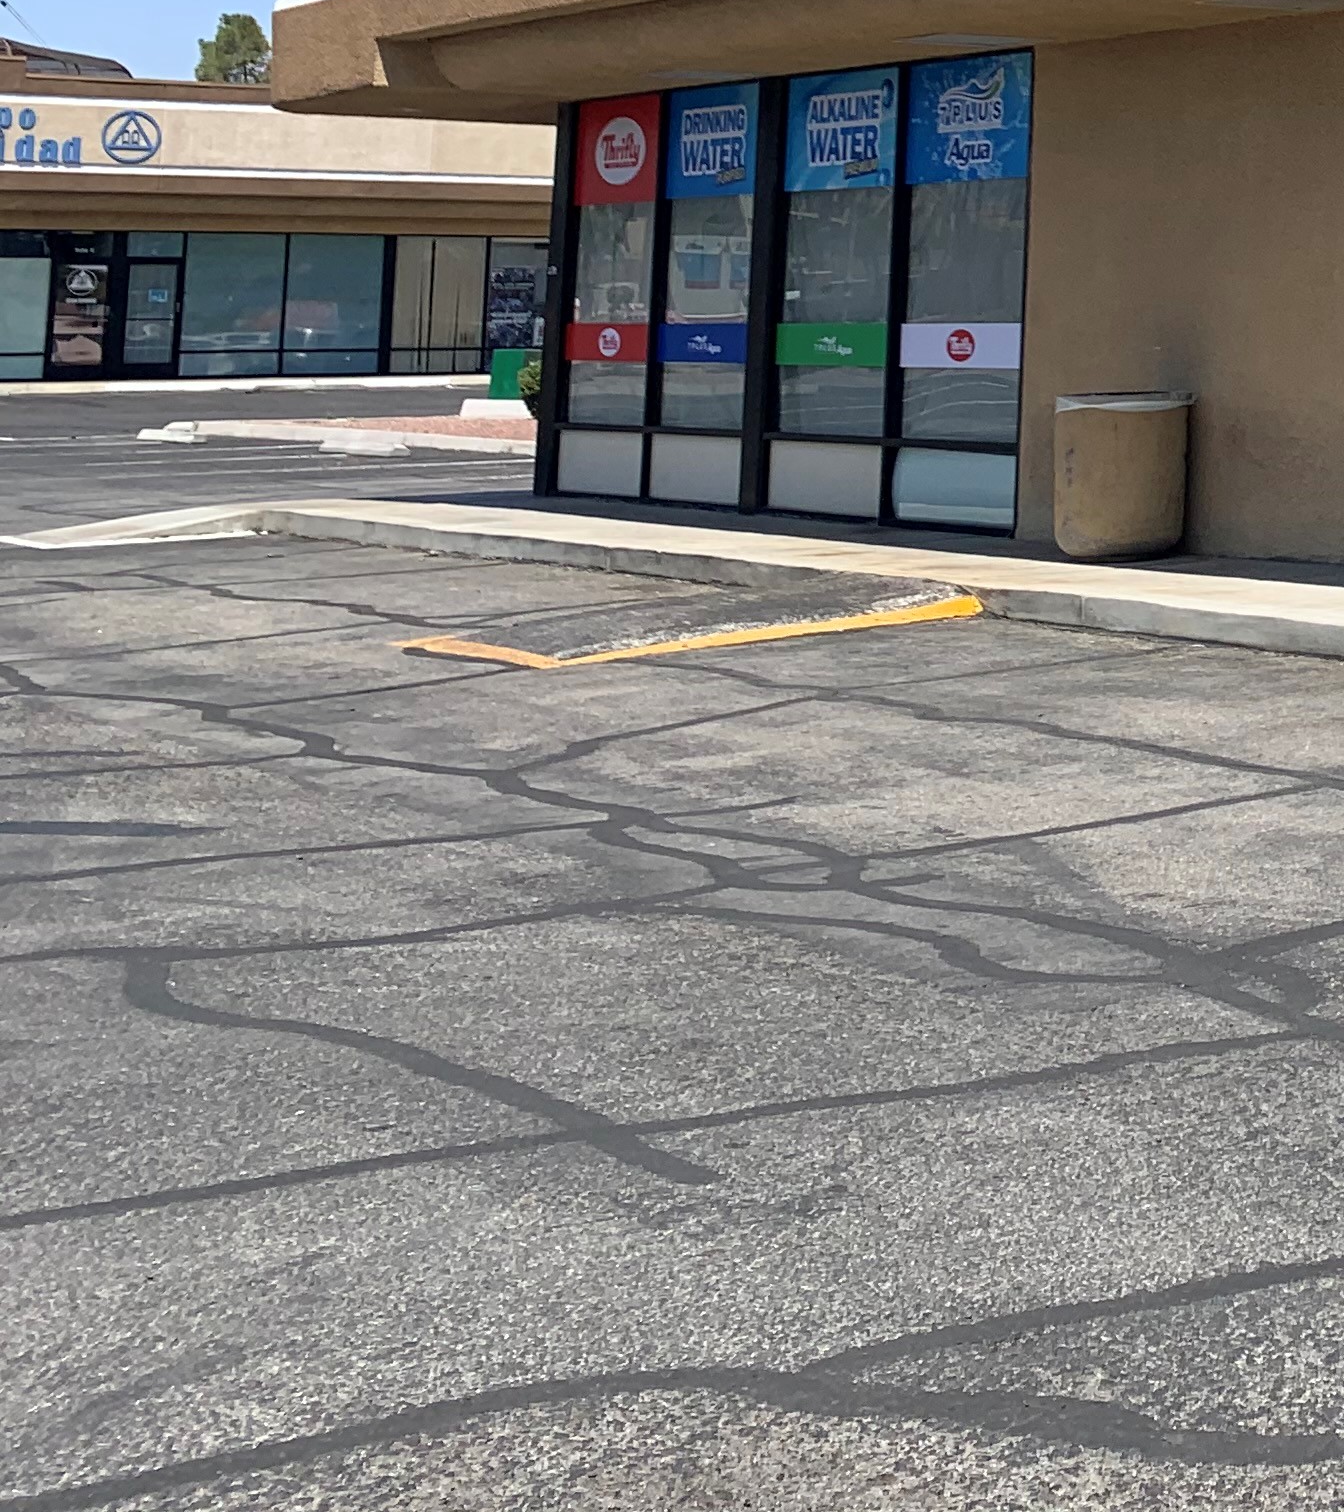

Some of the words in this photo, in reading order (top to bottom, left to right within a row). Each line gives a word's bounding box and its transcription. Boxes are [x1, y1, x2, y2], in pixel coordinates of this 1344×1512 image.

[683, 108, 745, 136] DRINKING
[810, 94, 880, 124] ALKALINE
[602, 131, 641, 163] Thrifty
[683, 136, 745, 173] WATER
[809, 124, 879, 163] WATER
[949, 136, 991, 165] Agua
